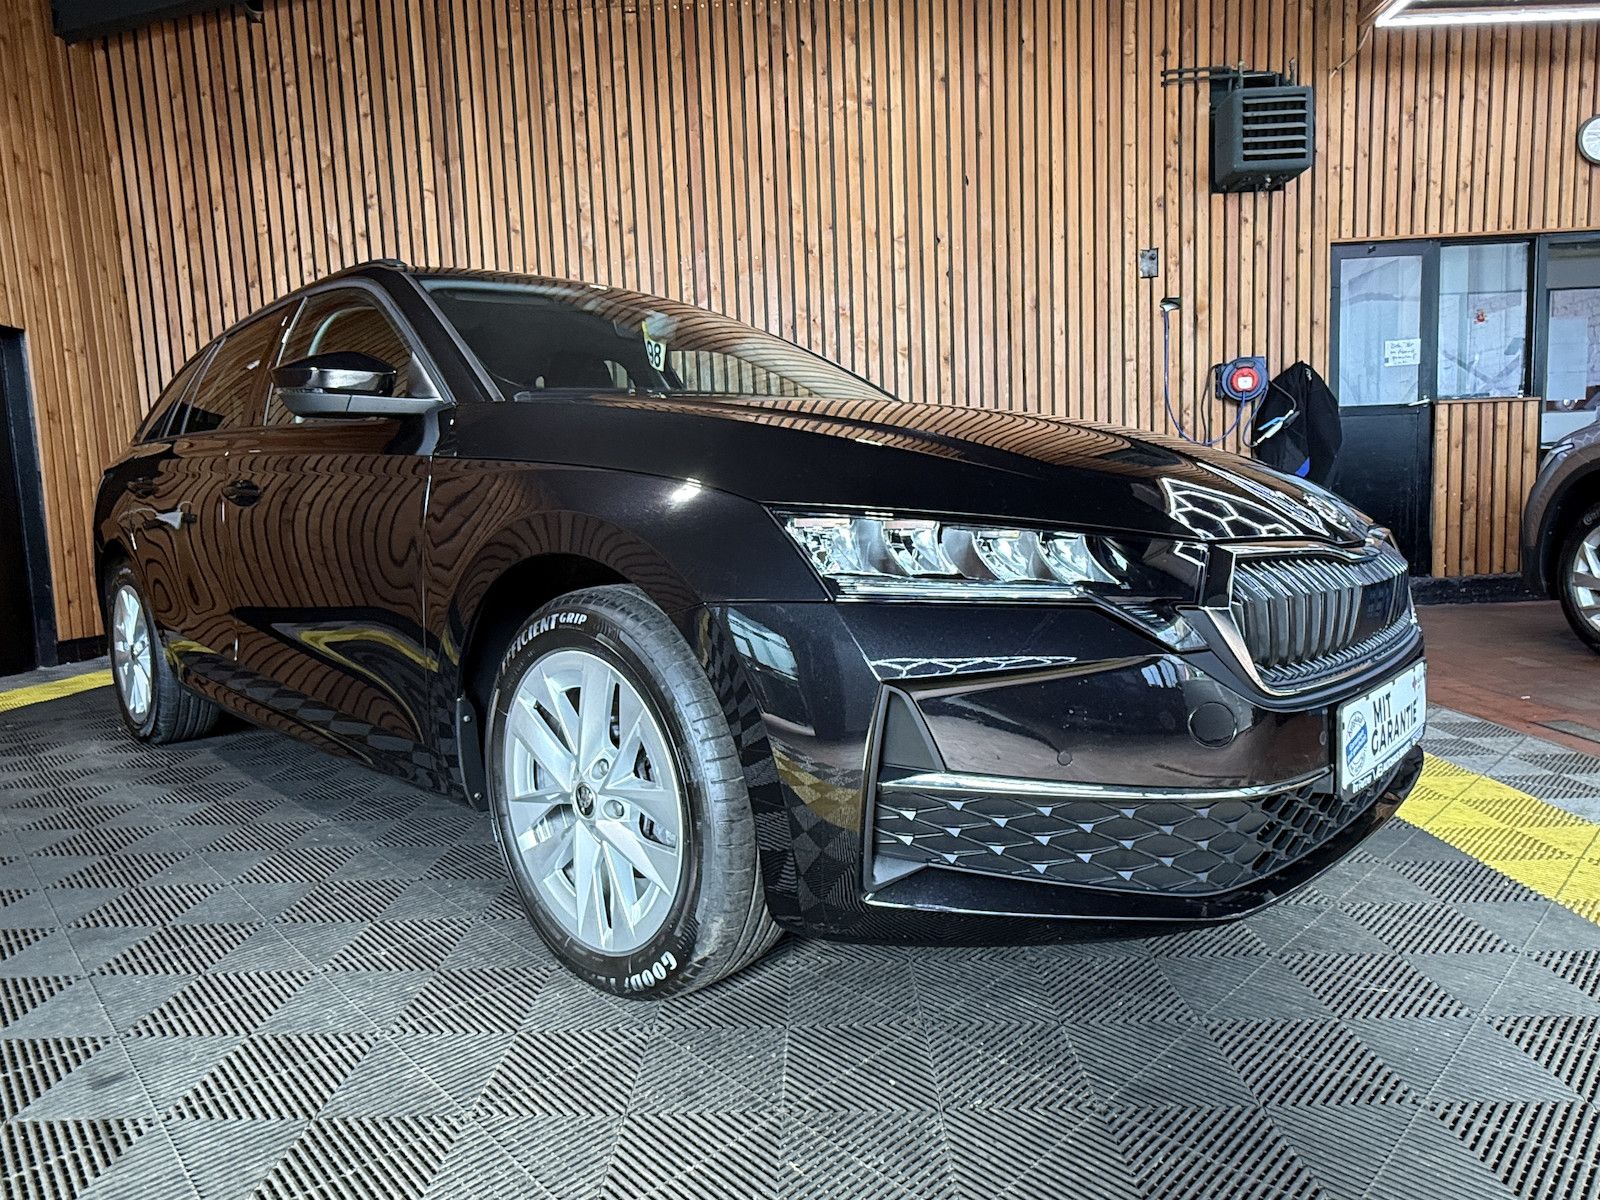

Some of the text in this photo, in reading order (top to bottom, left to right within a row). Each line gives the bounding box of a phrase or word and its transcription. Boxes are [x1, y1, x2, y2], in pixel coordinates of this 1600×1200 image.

[559, 612, 588, 625] GRIP
[1371, 696, 1418, 756] GARANTIE
[1373, 692, 1391, 727] MIT
